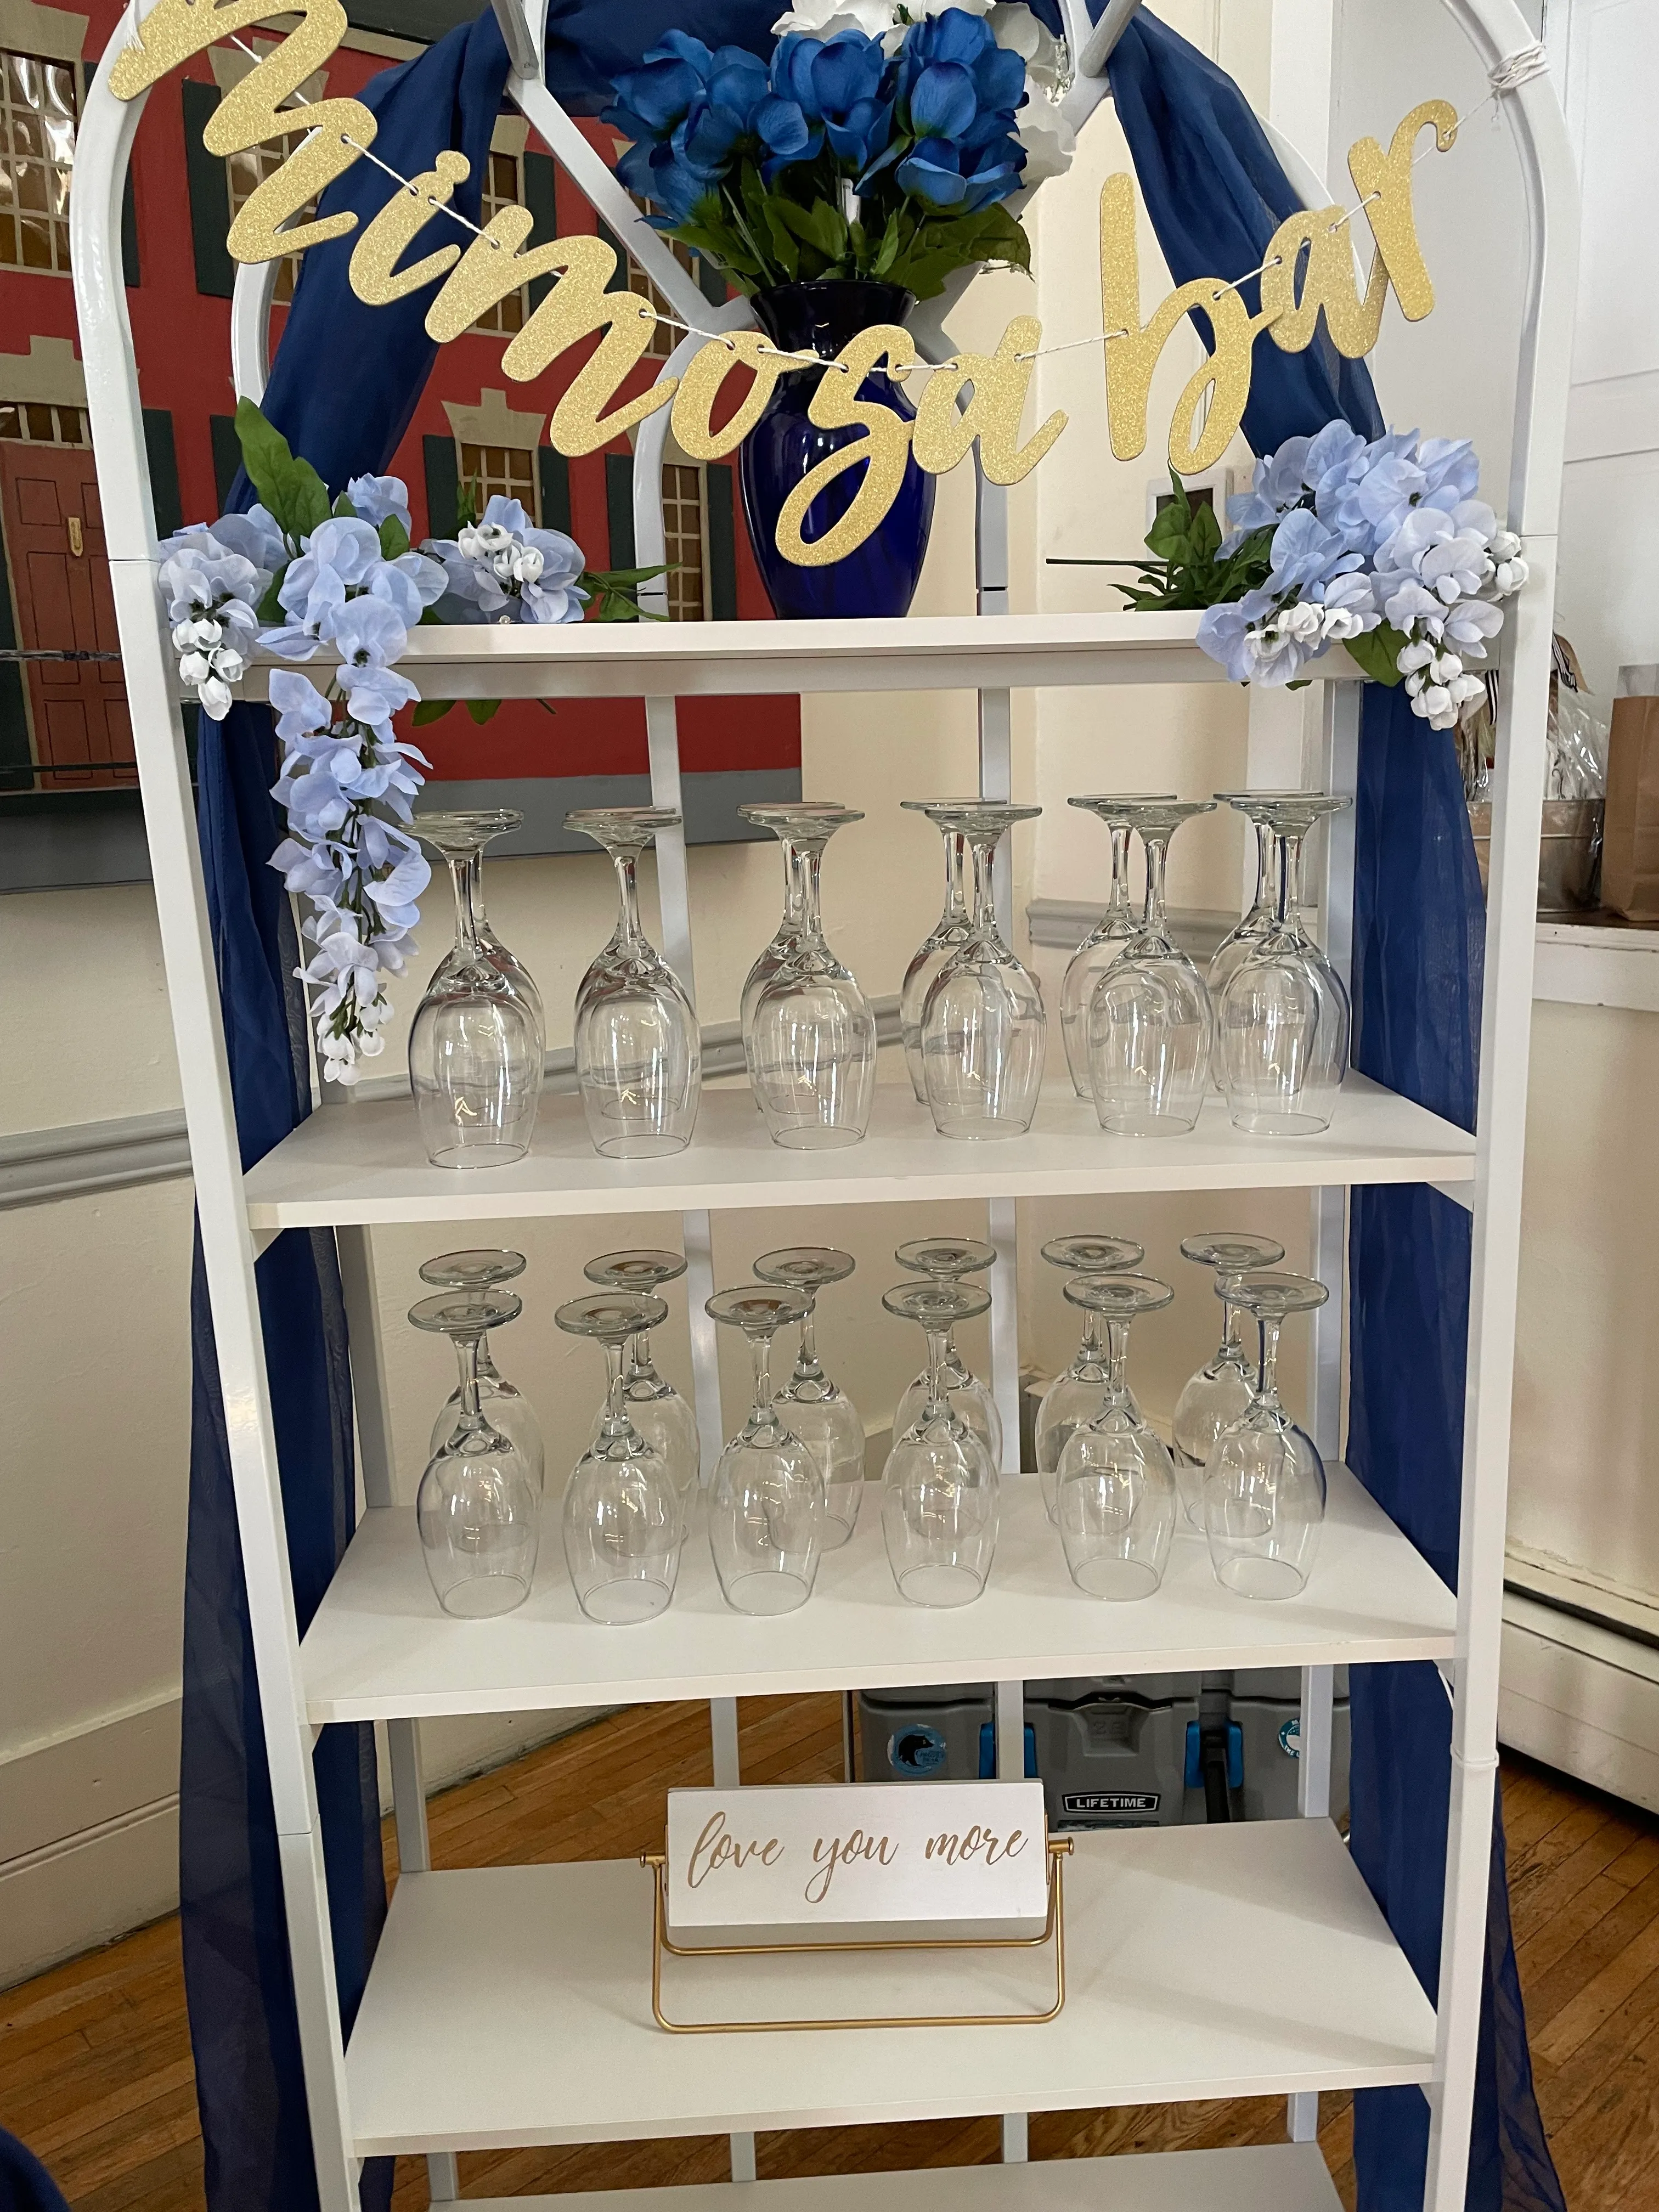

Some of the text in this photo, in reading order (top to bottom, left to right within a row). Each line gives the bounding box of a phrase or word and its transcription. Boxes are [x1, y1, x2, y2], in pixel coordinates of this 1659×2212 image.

[108, 0, 1457, 566] mimosa bar
[1076, 1797, 1146, 1808] LIFETIME
[688, 1811, 1029, 1904] love you more
